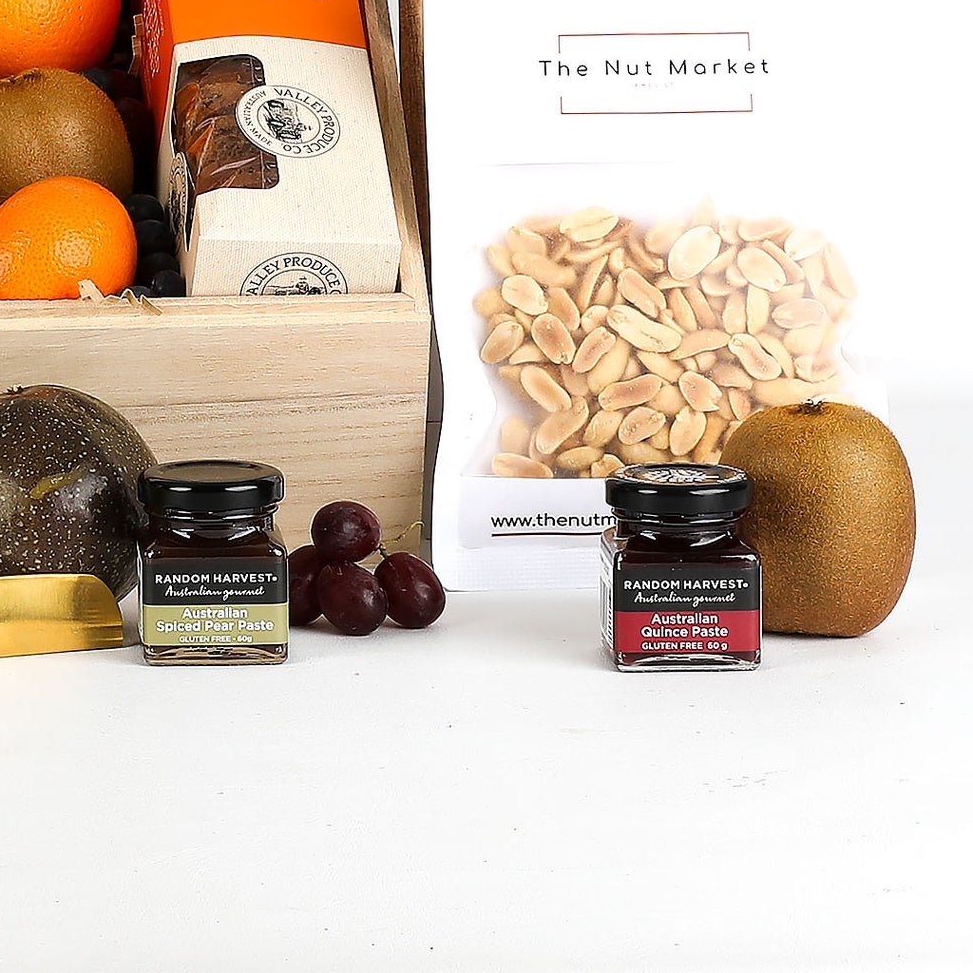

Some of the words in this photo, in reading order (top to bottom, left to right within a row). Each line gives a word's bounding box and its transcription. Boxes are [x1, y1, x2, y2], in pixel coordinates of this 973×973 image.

[538, 60, 588, 76] The
[605, 59, 652, 76] Nut
[669, 59, 769, 75] Market
[273, 87, 328, 114] VALLEY
[307, 115, 336, 154] PRODUCE
[283, 256, 341, 288] PRODUCE
[155, 574, 210, 584] RANDOM
[623, 580, 680, 590] RANDOM
[165, 585, 222, 598] Australian
[222, 586, 265, 601] gourmet
[634, 591, 692, 603] Australian
[692, 593, 736, 607] gourmet
[182, 607, 248, 619] Australian
[651, 613, 718, 624] Australian
[156, 620, 201, 633] Spiced
[204, 620, 235, 631] Pear
[238, 620, 275, 631] Paste
[640, 626, 689, 638] Quince
[691, 626, 729, 637] Paste
[179, 635, 209, 643] GLUTEN
[211, 635, 232, 643] FREE
[642, 642, 679, 650] GLUTEN
[680, 642, 703, 650] FREE
[707, 641, 720, 650] 60
